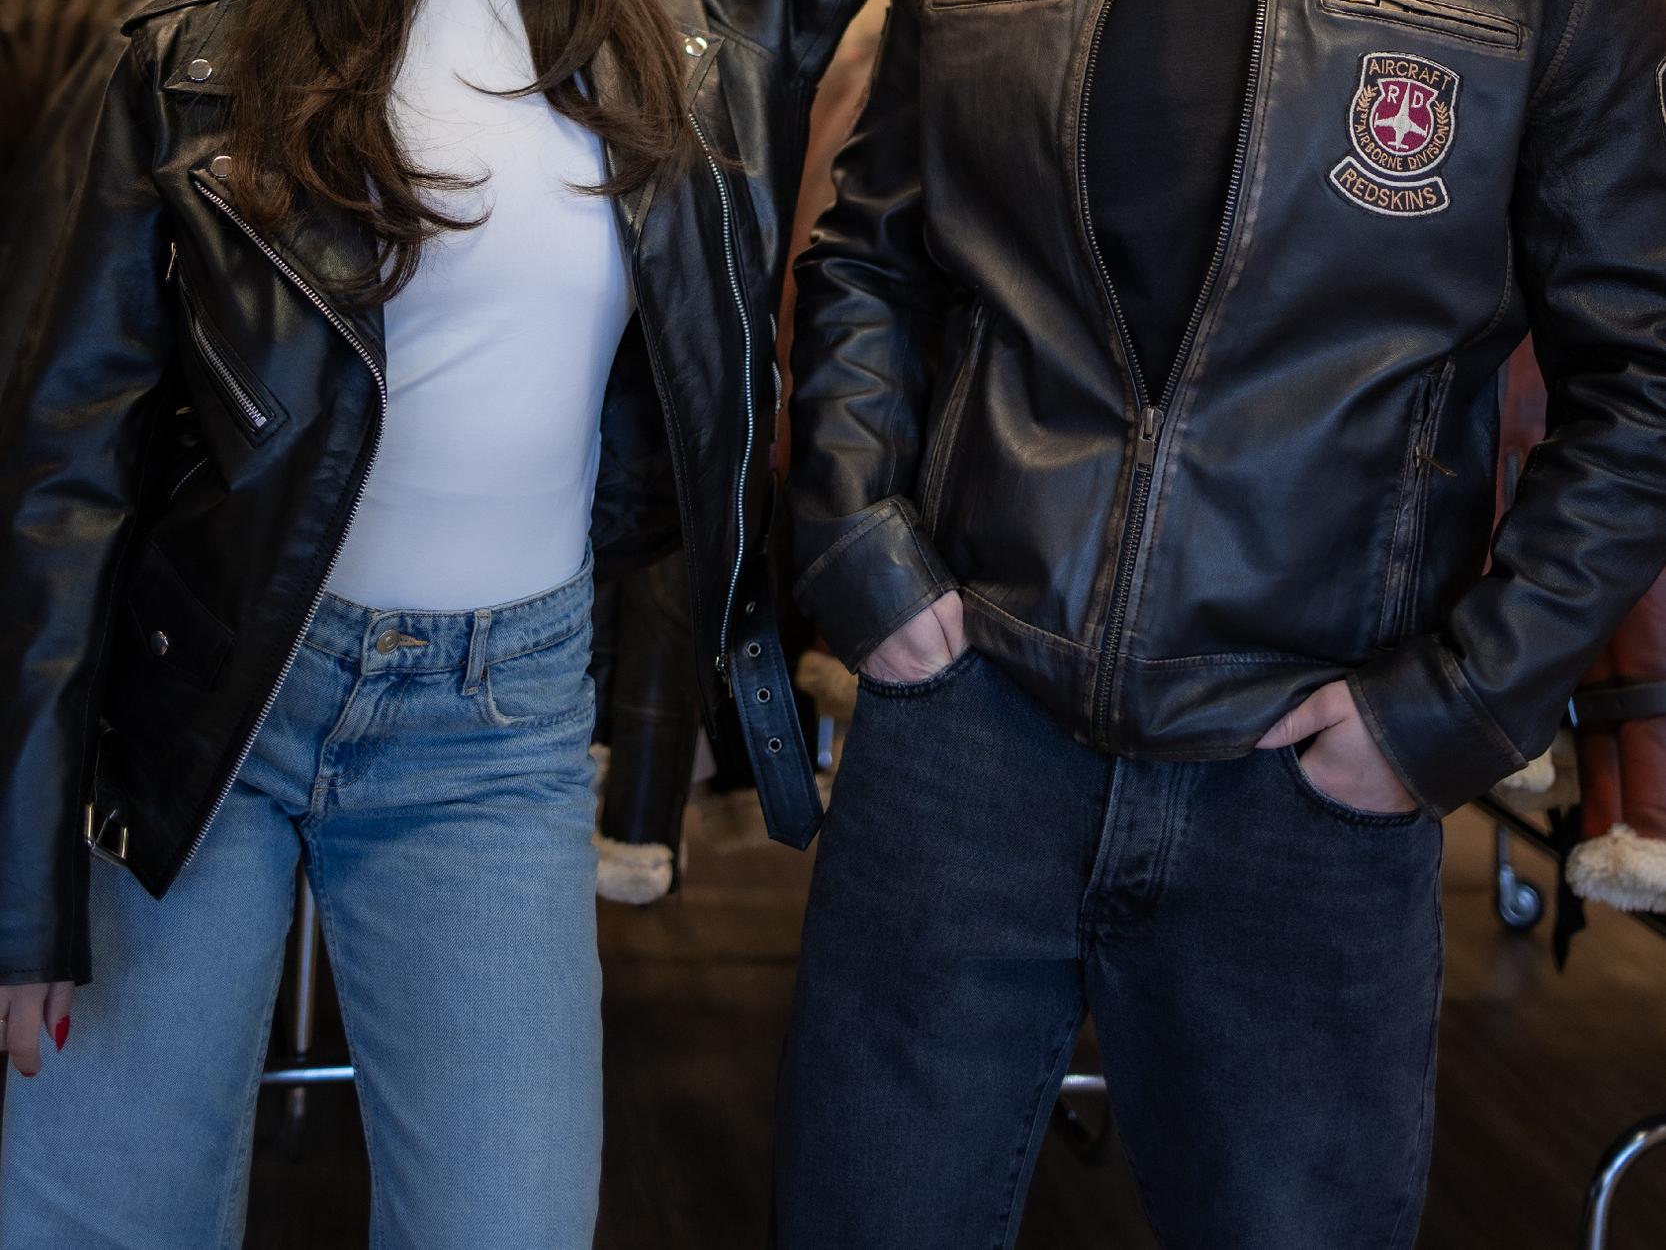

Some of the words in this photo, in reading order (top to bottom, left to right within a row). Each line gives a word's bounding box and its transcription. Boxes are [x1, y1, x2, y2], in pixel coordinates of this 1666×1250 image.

[1369, 59, 1451, 91] AIRCRAFT
[1387, 85, 1400, 104] R
[1411, 90, 1424, 108] D
[1354, 124, 1404, 170] AIRBORNE
[1408, 123, 1450, 170] DIVISION
[1339, 167, 1438, 210] REDSKINS
